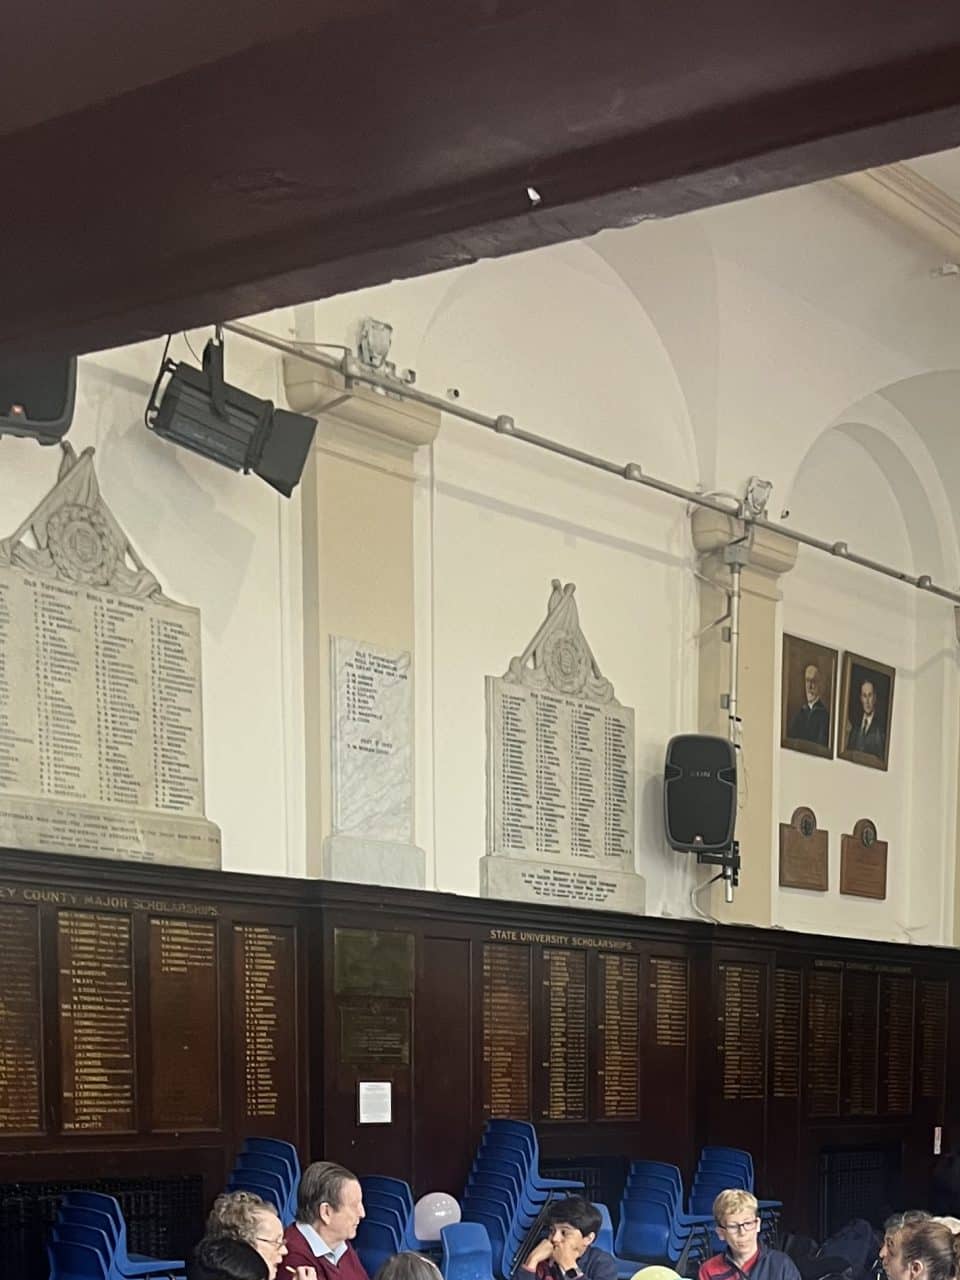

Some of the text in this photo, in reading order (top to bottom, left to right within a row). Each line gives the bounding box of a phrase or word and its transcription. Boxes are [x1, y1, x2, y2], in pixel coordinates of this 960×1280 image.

[23, 889, 78, 905] COUNTY
[84, 895, 129, 909] MAJOR
[489, 929, 633, 951] STATE UNIVERSITY SCHOLARSHIPS
